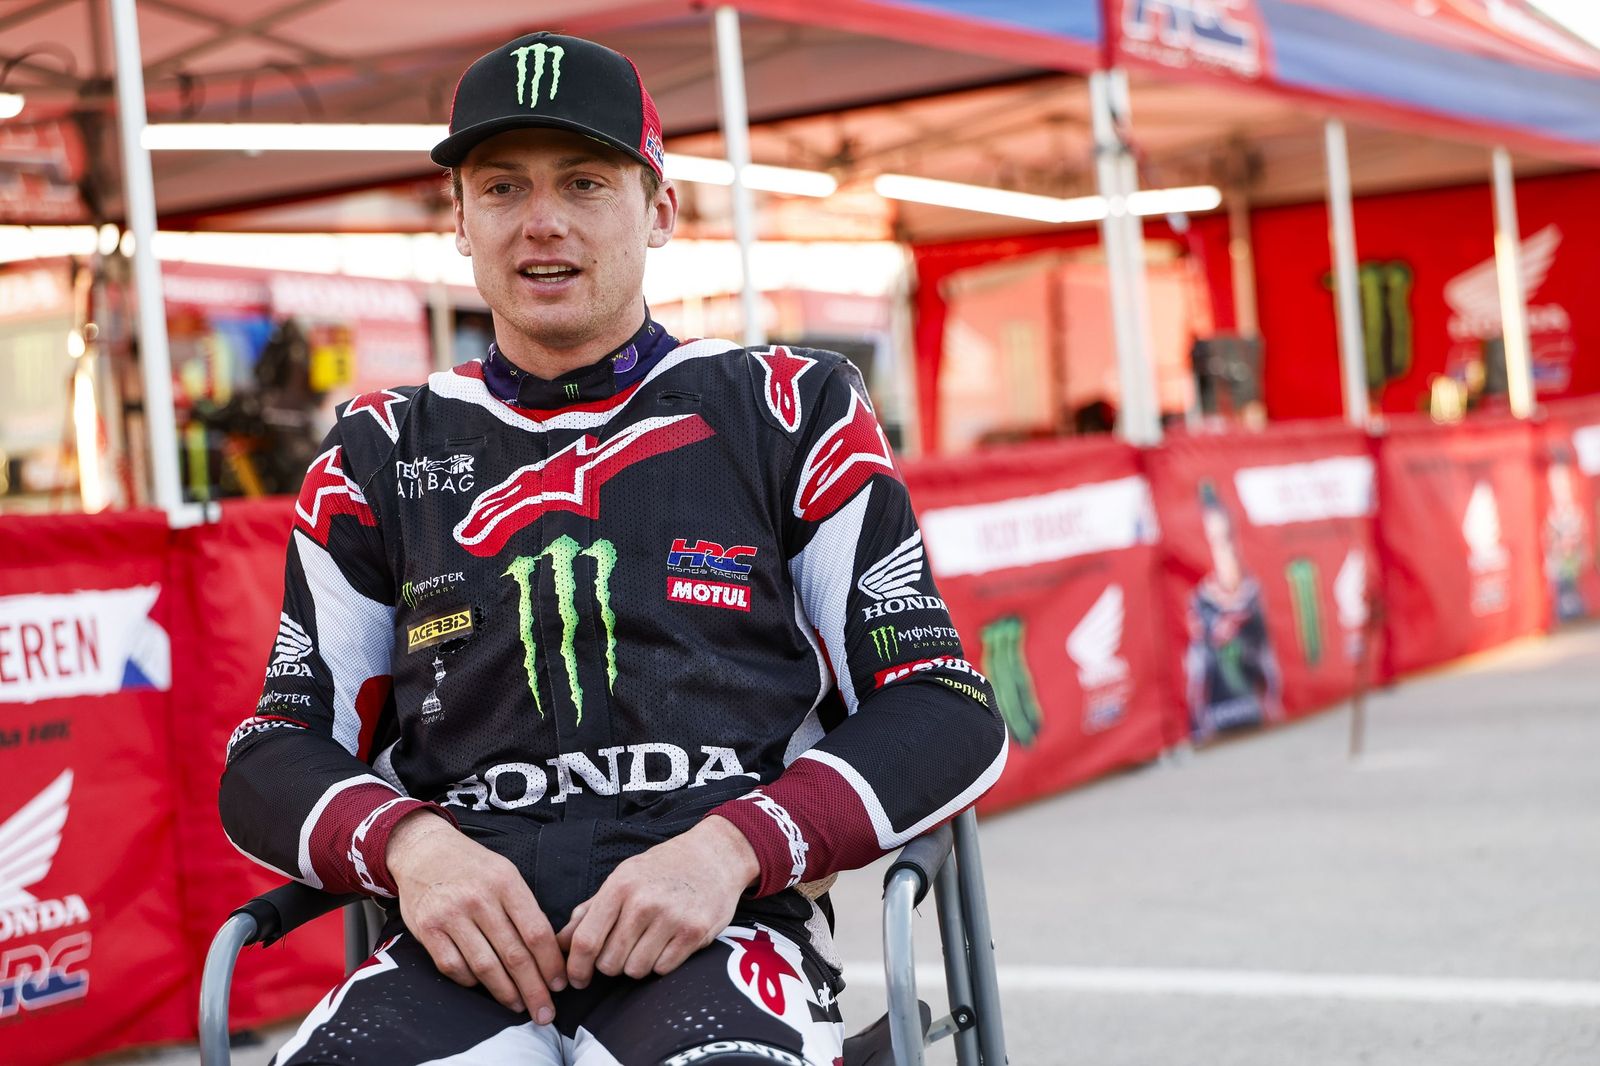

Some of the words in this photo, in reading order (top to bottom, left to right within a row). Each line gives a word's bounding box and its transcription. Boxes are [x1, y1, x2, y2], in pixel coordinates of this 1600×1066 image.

[397, 474, 475, 499] AIRBAG
[666, 538, 758, 575] HRC
[412, 571, 466, 595] MONSTER
[709, 568, 748, 581] RACING
[671, 581, 747, 608] MOTUL
